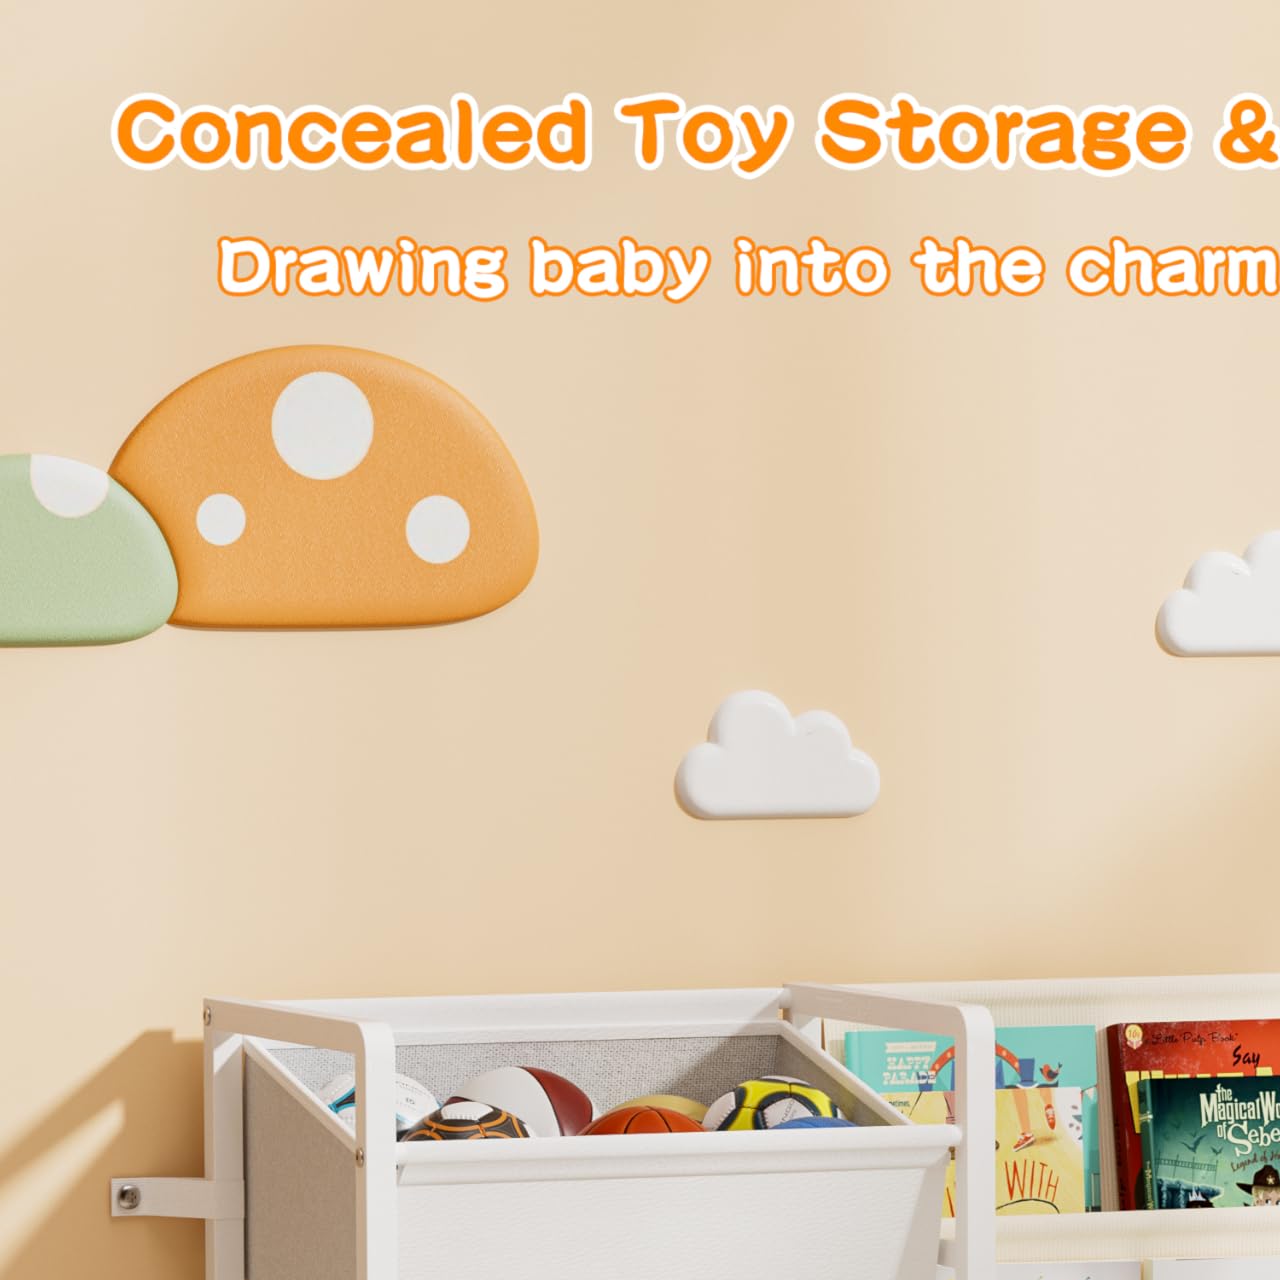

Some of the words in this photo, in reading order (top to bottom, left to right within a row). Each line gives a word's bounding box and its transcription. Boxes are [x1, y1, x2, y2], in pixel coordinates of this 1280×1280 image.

[1232, 1044, 1260, 1069] Say
[1216, 1083, 1233, 1102] the
[1199, 1092, 1260, 1128] Magical
[1216, 1121, 1228, 1140] of
[1004, 1159, 1060, 1203] WITH
